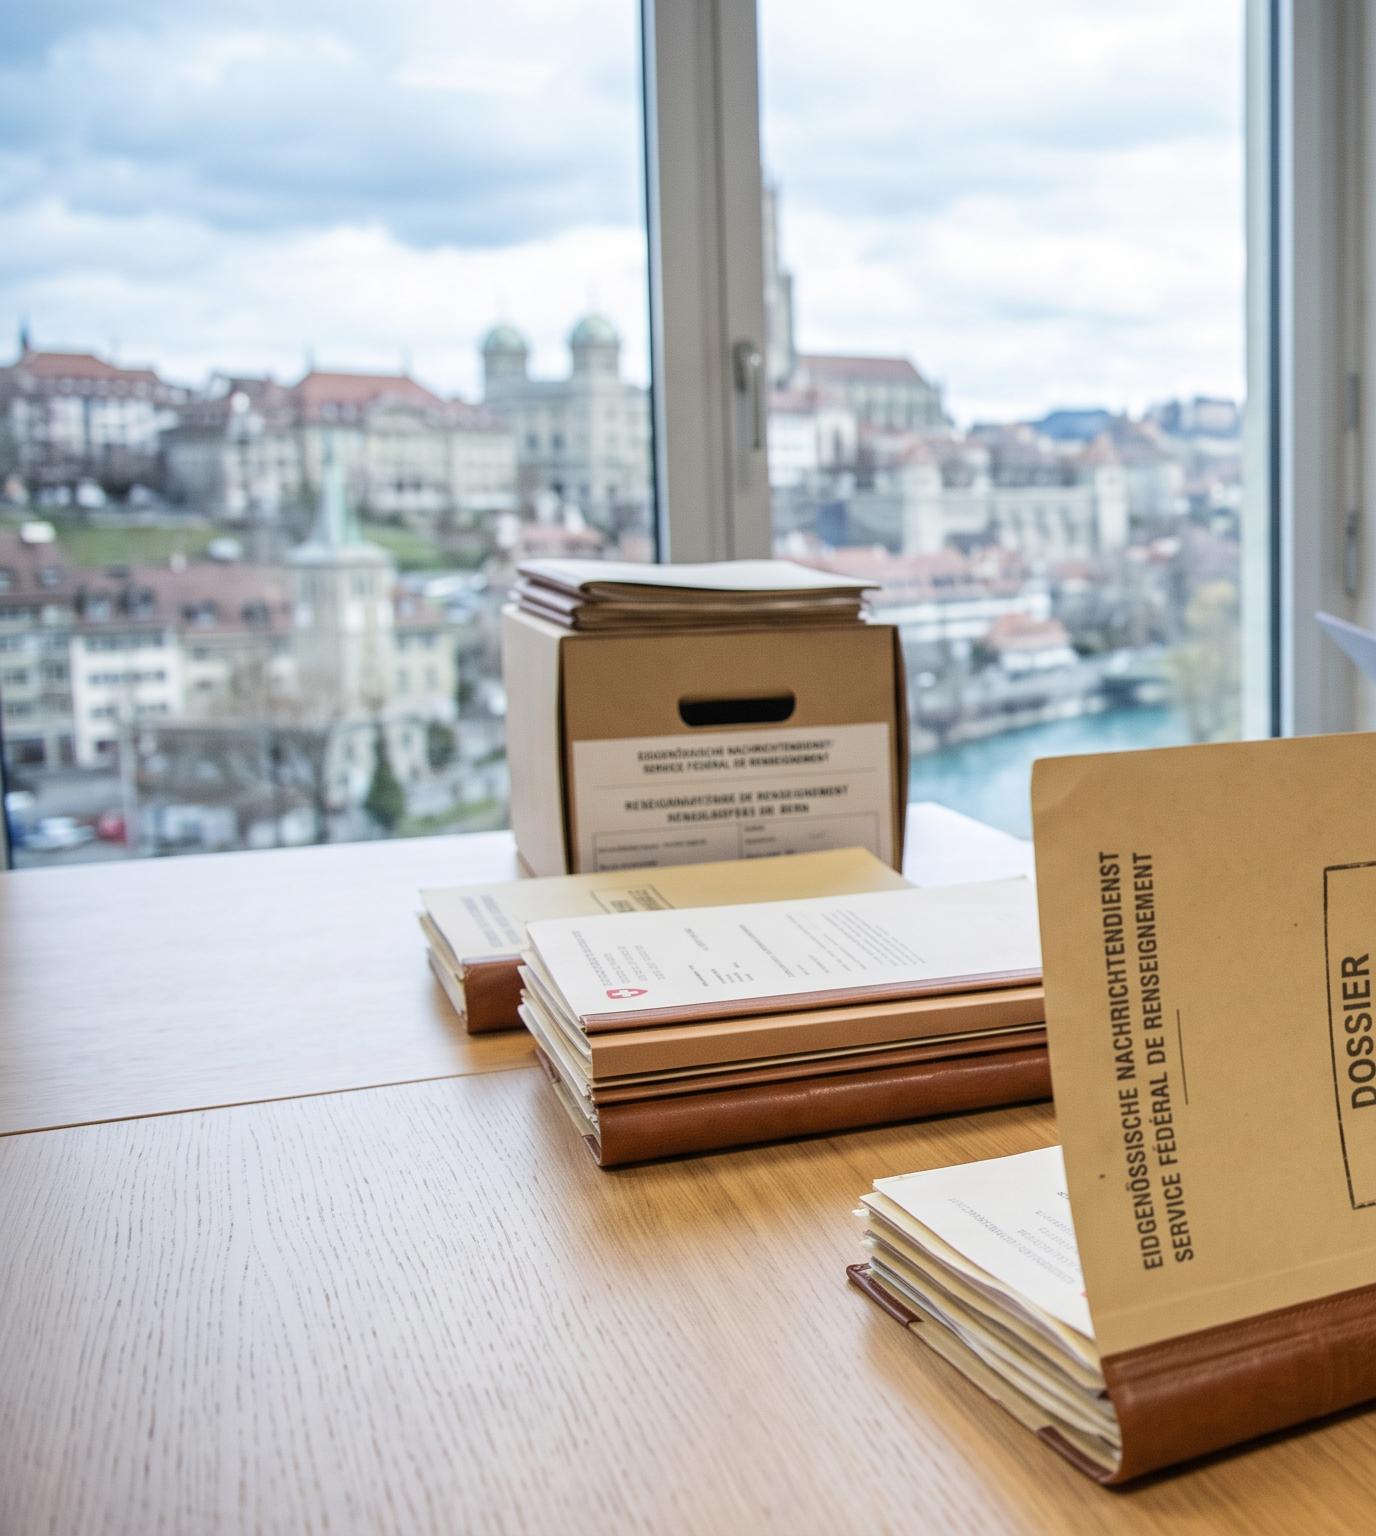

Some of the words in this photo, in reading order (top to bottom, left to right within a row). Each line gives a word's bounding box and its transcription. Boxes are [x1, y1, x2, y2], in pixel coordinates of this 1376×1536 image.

[1099, 851, 1136, 1081] NACHRICHTENDIENST
[1132, 852, 1163, 1030] RENSEIGNEMENT
[1145, 1036, 1166, 1066] DE
[1149, 1071, 1179, 1167] FÉDÉRAL
[1119, 1087, 1164, 1271] EIDGENÖSSISCHE
[1141, 1172, 1195, 1263] SERVICE
